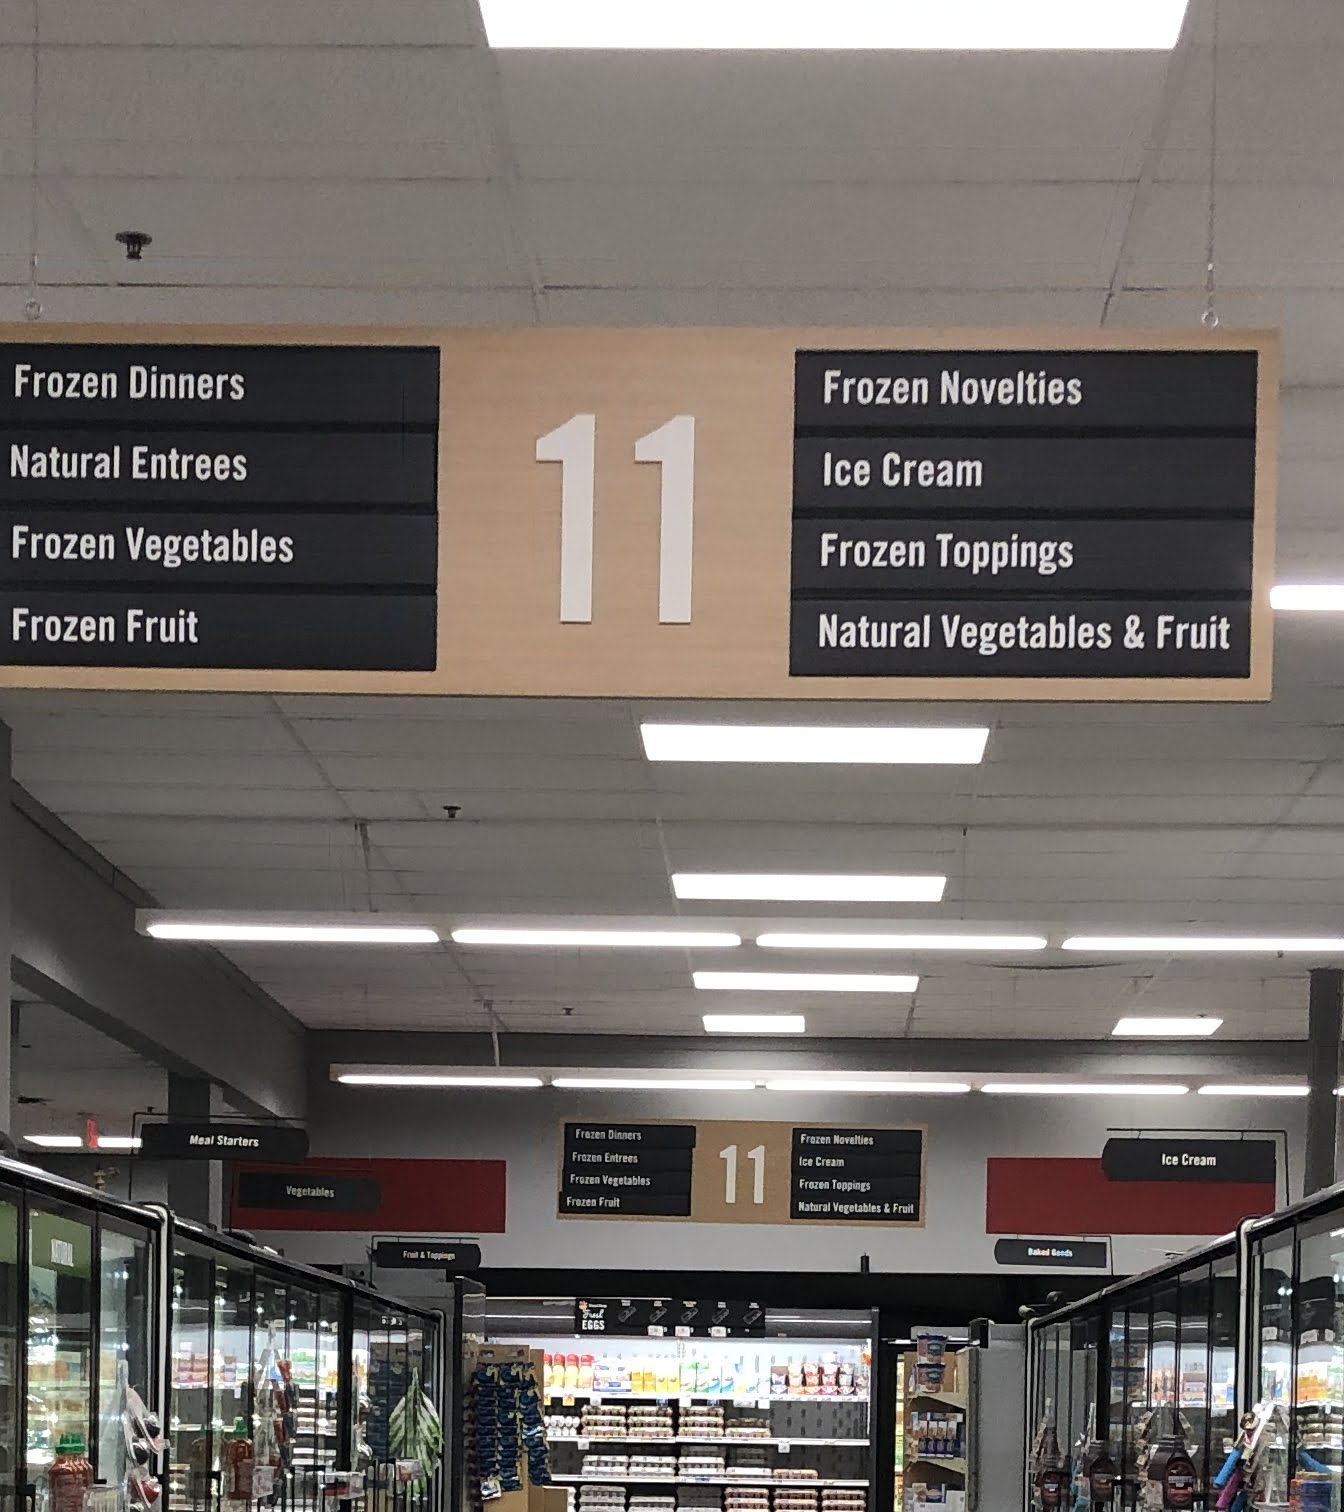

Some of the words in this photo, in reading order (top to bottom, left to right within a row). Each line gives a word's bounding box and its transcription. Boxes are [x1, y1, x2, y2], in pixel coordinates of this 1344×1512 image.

[14, 364, 118, 399] Frozen
[129, 365, 245, 400] Dinners
[823, 369, 929, 406] Frozen
[940, 370, 1083, 406] Novelties
[10, 444, 121, 479] Natural
[132, 445, 247, 481] Entrees
[823, 451, 871, 487] Ice
[882, 451, 983, 488] Cream
[536, 414, 695, 623] 11
[12, 524, 115, 560] Frozen
[125, 526, 294, 568] Vegetables
[820, 532, 926, 568] Frozen
[935, 532, 1074, 575] Toppings
[12, 607, 115, 643] Frozen
[127, 608, 199, 644] Fruit
[818, 613, 931, 649] Natural
[940, 614, 1112, 656] Vegetables
[1123, 614, 1145, 650] &
[1156, 614, 1231, 650] Fruit
[189, 1134, 215, 1146] Meal
[216, 1134, 260, 1148] Starters
[575, 1128, 606, 1140] Frozen
[608, 1129, 642, 1141] Dinners
[800, 1133, 832, 1145] Frozen
[833, 1134, 874, 1146] Novelties
[572, 1151, 603, 1163] Frozen
[604, 1152, 639, 1164] Entrees
[798, 1155, 814, 1167] Ice
[815, 1156, 845, 1167] Cream
[1161, 1153, 1179, 1166] Ice
[1181, 1153, 1217, 1167] Cream
[569, 1173, 601, 1185] Frozen
[602, 1174, 651, 1188] Vegetables
[718, 1144, 766, 1205] 11
[286, 1185, 335, 1198] Vegetables
[799, 1178, 830, 1190] Frozen
[831, 1179, 871, 1193] Toppings
[566, 1196, 597, 1208] Frozen
[598, 1196, 621, 1208] Fruit
[798, 1201, 831, 1213] Natural
[832, 1201, 882, 1215] Vegetables
[883, 1202, 891, 1214] &
[892, 1202, 915, 1214] Fruit
[1027, 1247, 1050, 1258] Baked
[581, 1319, 605, 1330] EGGS
